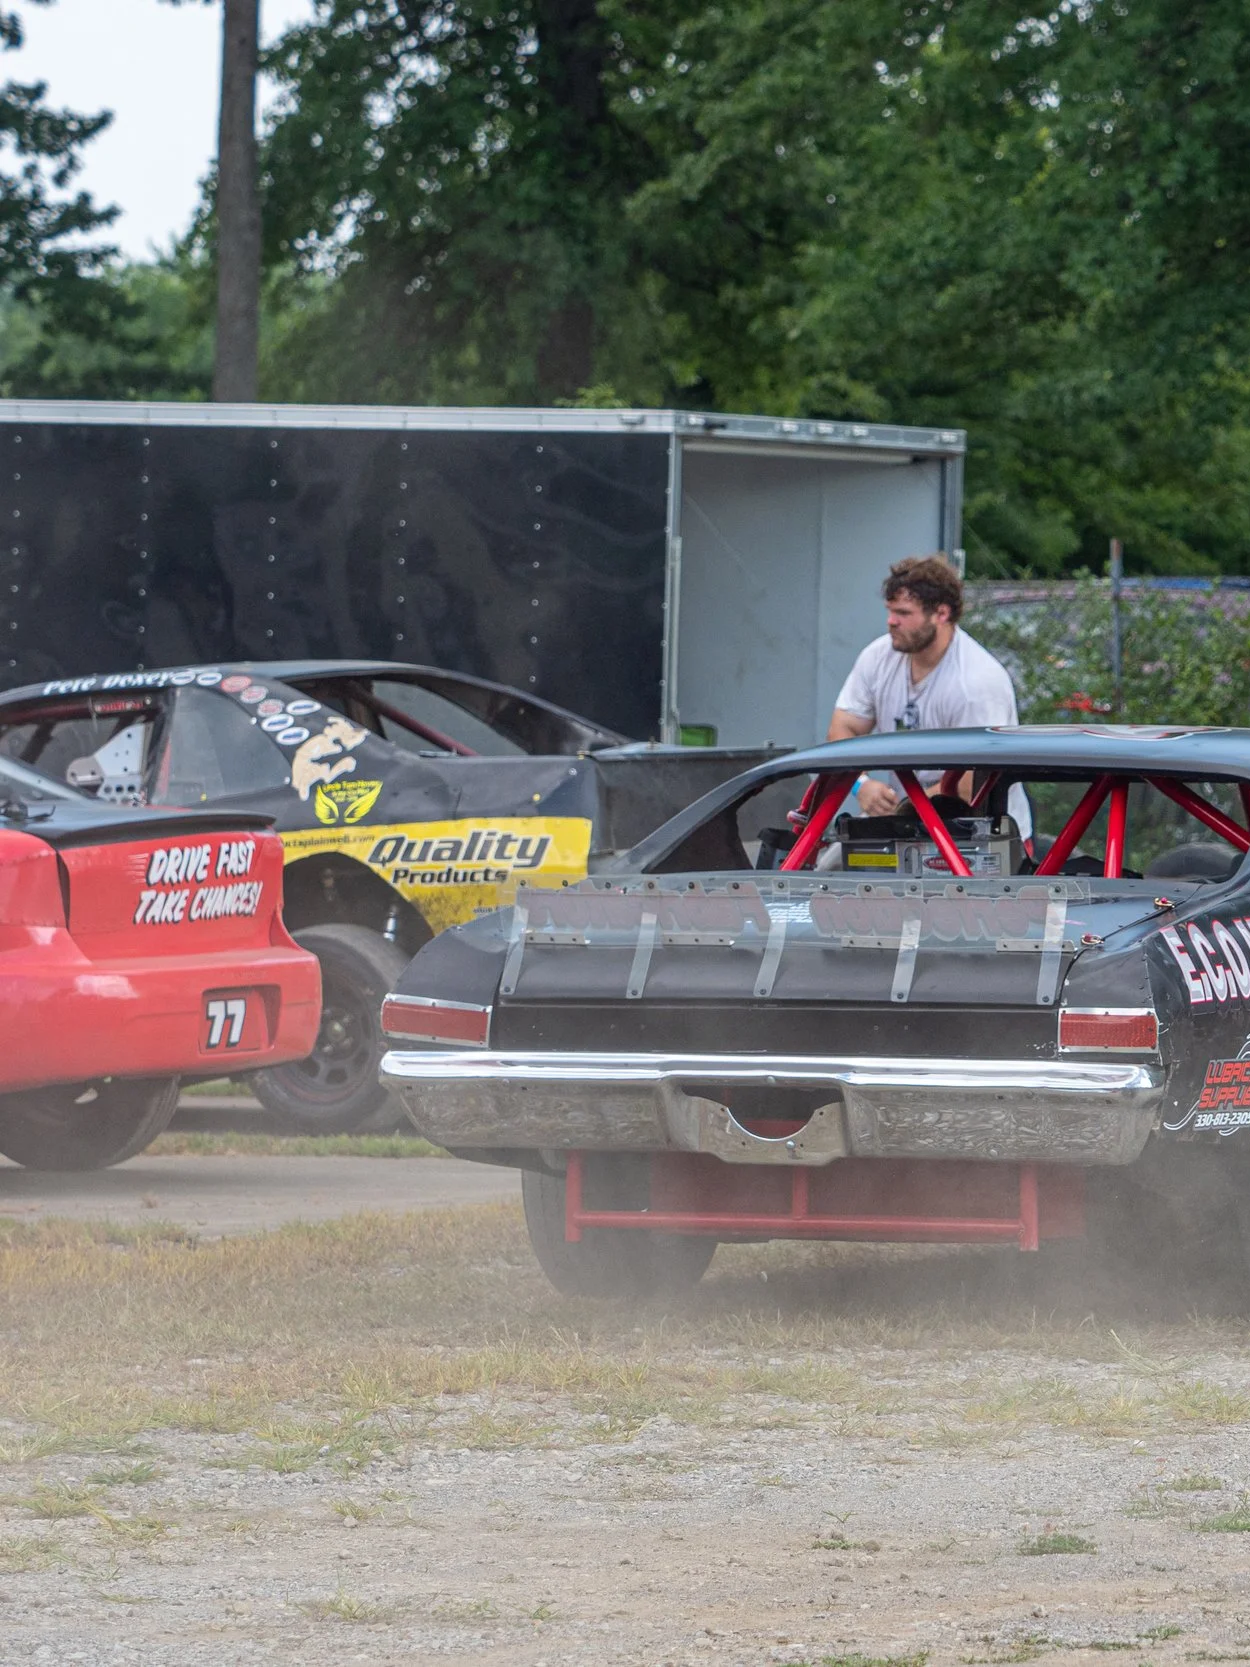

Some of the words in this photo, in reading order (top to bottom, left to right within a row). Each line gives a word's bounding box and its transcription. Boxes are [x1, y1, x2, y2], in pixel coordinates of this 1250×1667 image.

[147, 843, 212, 886] DRIVE
[215, 840, 256, 879] FAST
[367, 830, 552, 869] Quality
[391, 867, 510, 885] Products
[133, 889, 190, 924] TAKE
[188, 881, 263, 922] CHANCES!
[205, 999, 246, 1050] 77
